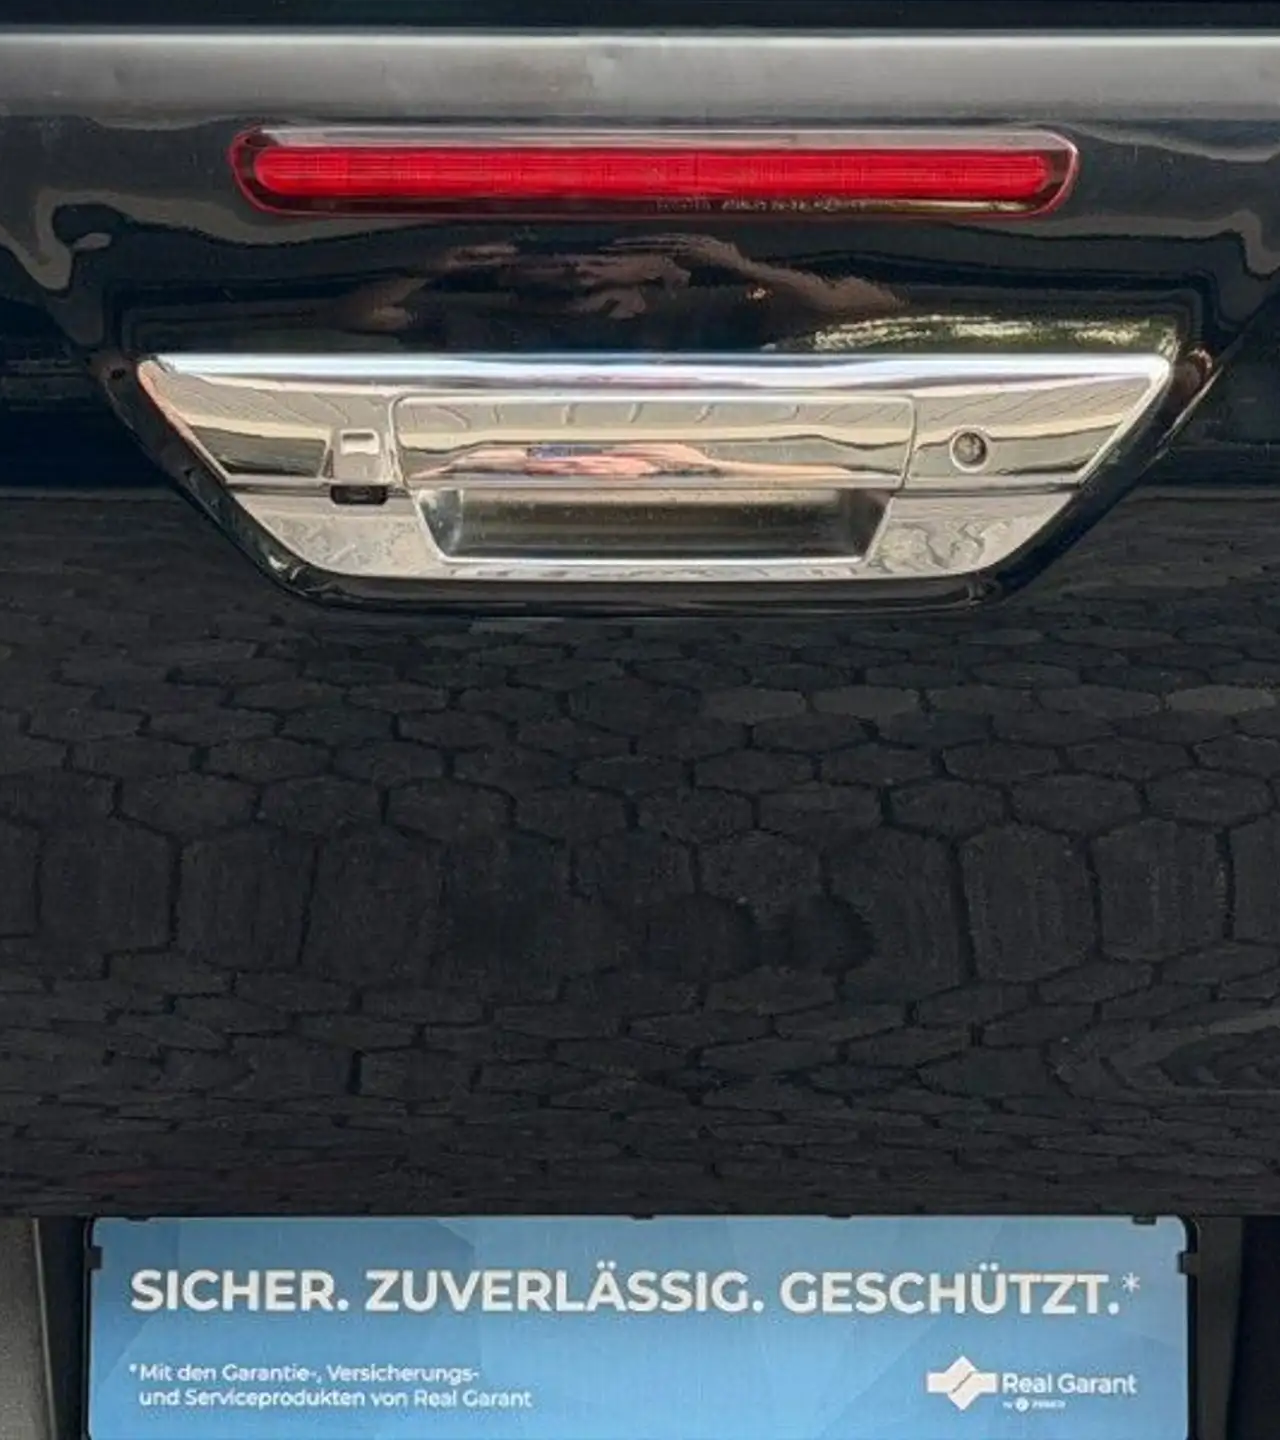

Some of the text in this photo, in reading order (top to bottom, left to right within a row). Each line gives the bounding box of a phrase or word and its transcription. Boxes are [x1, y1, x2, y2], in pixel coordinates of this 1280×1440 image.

[130, 1268, 350, 1312] SICHER.
[365, 1260, 765, 1313] ZUVERLÄSSIG.
[176, 1363, 217, 1382] den
[326, 1363, 480, 1385] Versicherungs-
[1002, 1372, 1138, 1395] Real Garant
[139, 1388, 534, 1411] und Serviceprodukten von Real Garant
